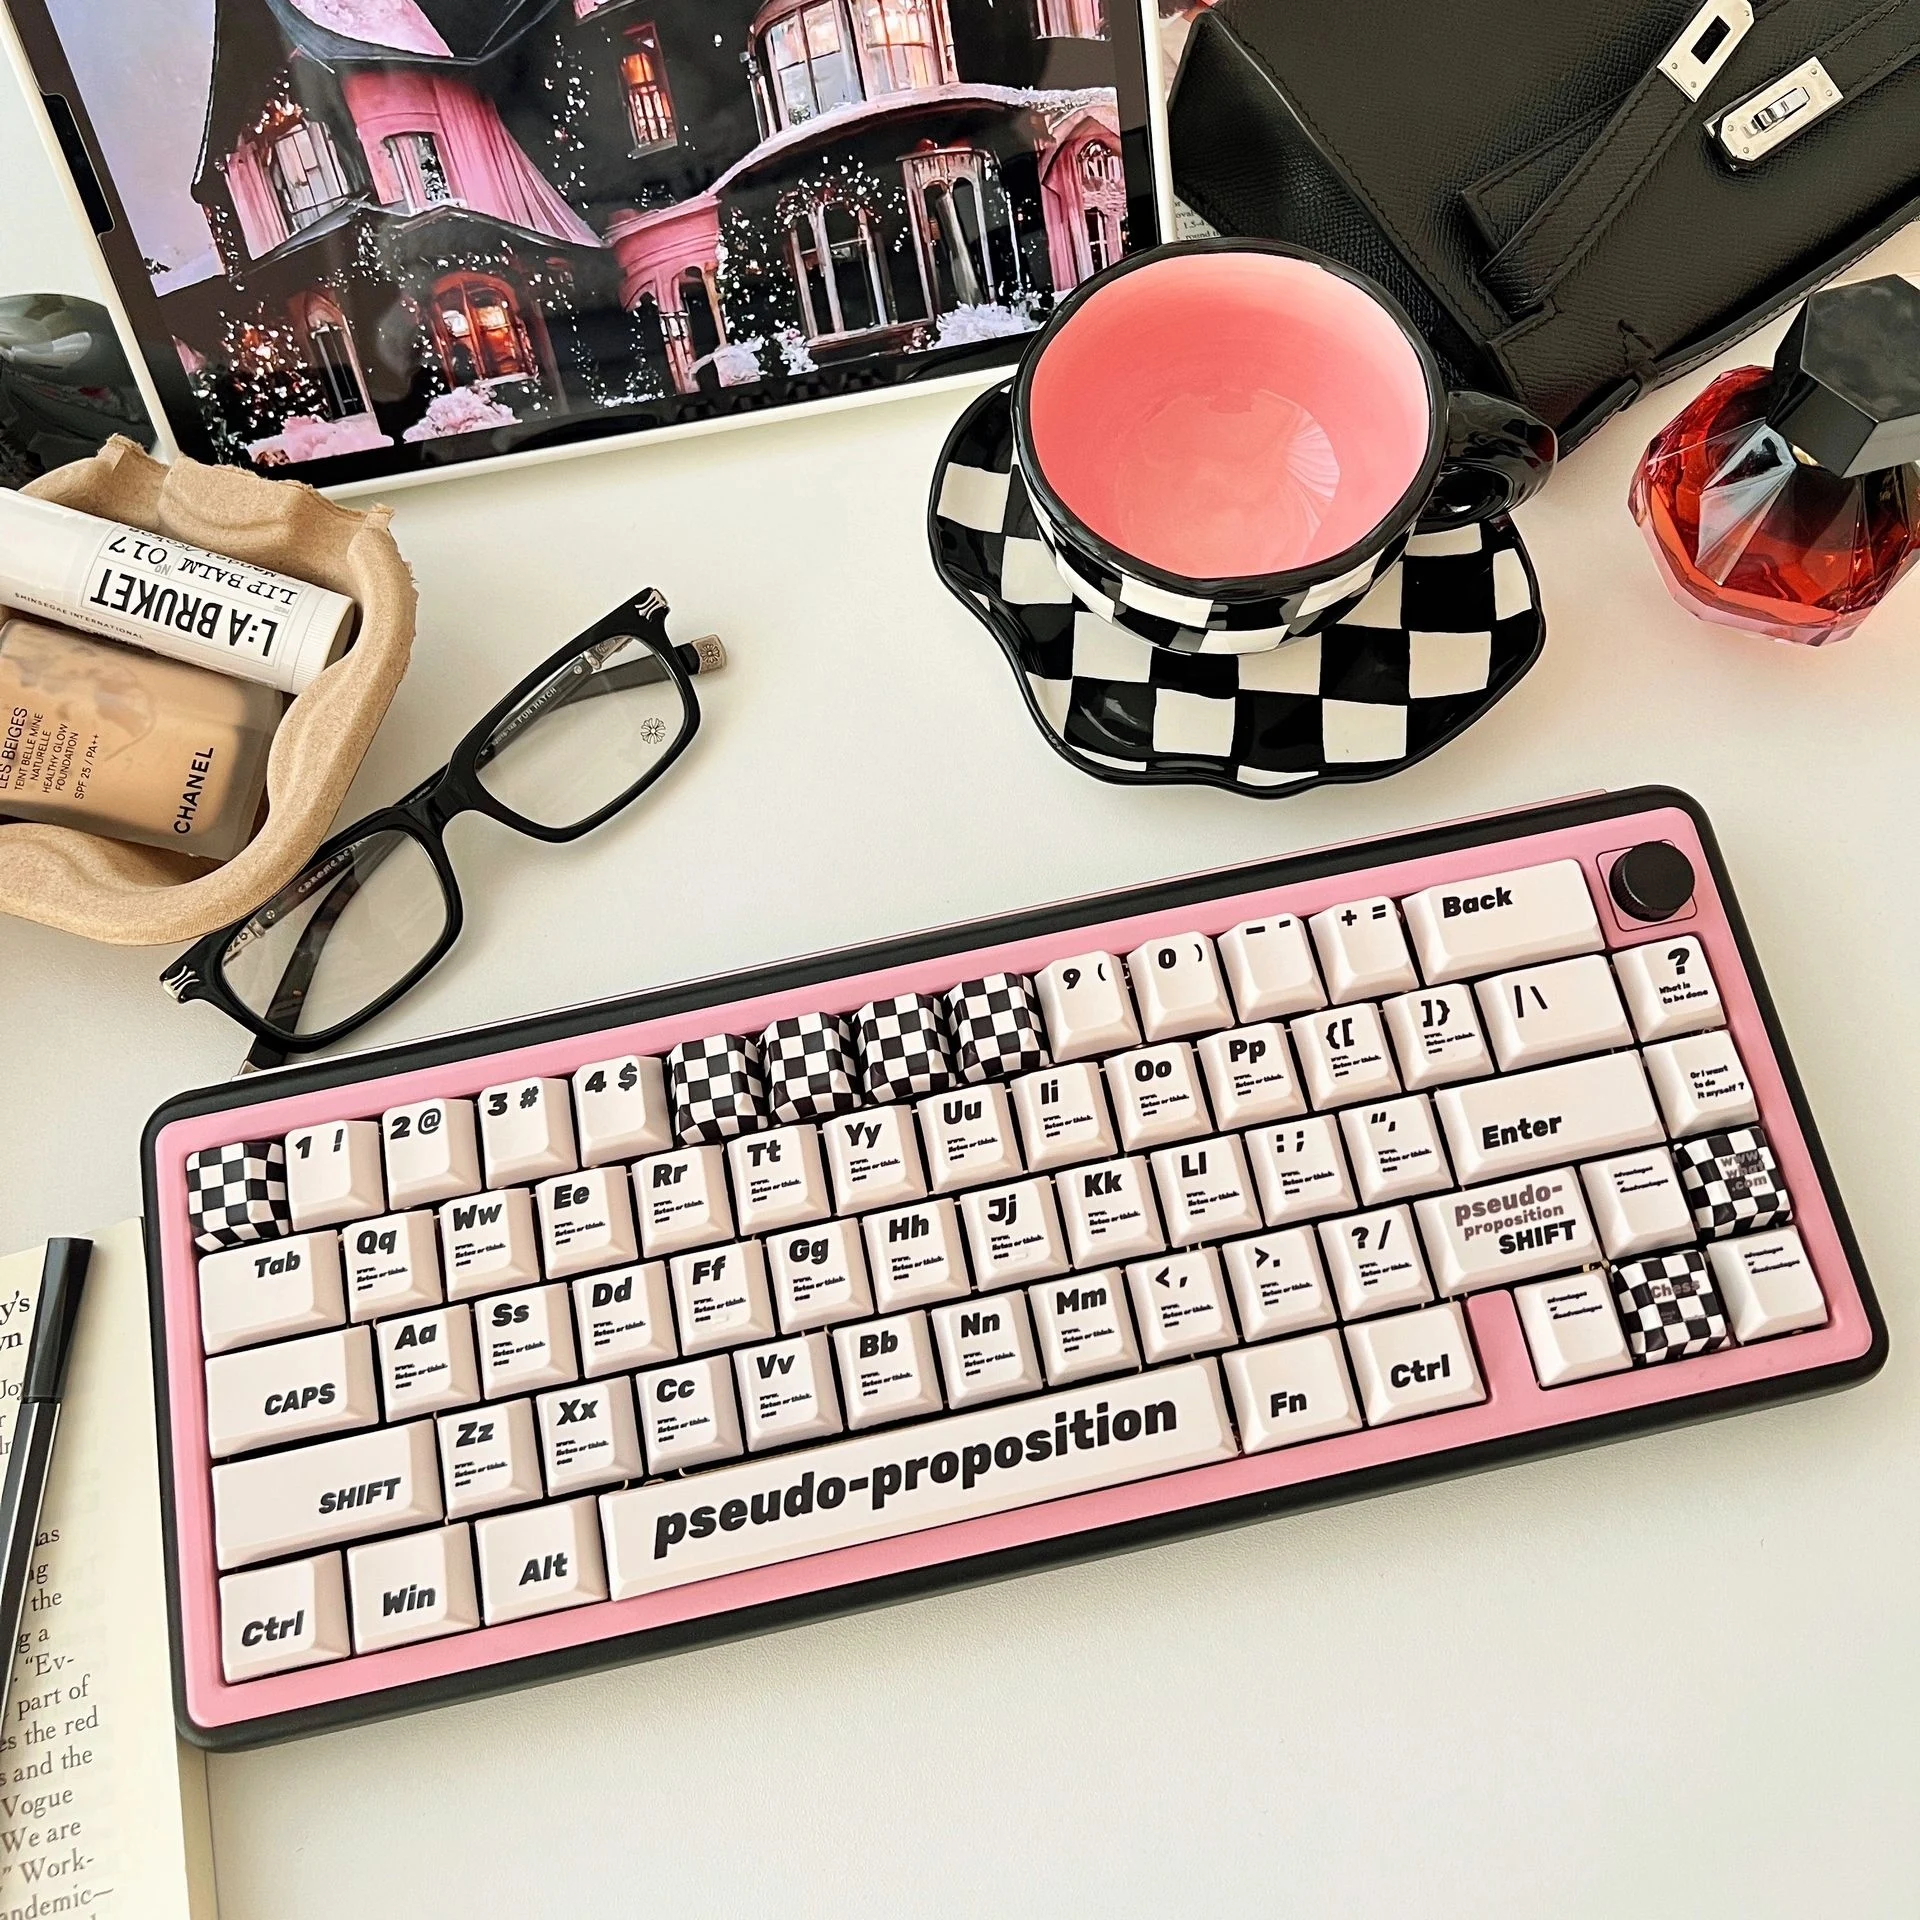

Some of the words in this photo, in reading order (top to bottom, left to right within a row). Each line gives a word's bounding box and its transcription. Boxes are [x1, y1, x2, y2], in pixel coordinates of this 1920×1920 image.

[178, 557, 244, 589] BALM
[90, 568, 223, 640] BRUKET
[246, 581, 298, 605] LIP
[15, 592, 67, 614] SHINSEGAE
[70, 611, 144, 639] INTERNATIONAL
[229, 608, 279, 657] L:A
[517, 709, 533, 726] FUN
[2, 707, 28, 761] BEIGES
[15, 768, 27, 790] TEINT
[21, 739, 36, 766] BELLE
[29, 713, 43, 737] MINE
[30, 730, 51, 780] NATURELLE
[42, 755, 58, 793] HEALTHY
[53, 723, 68, 753] GLOW
[56, 732, 78, 791] FOUNDATION
[74, 780, 87, 800] SPF
[81, 767, 91, 779] 25
[86, 735, 99, 758] PA++
[174, 747, 214, 834] CHANEL
[1342, 910, 1357, 926] +
[1372, 905, 1386, 919] =
[1443, 887, 1512, 918] Back
[1668, 948, 1689, 975] ?
[1063, 969, 1080, 989] 9
[1098, 964, 1106, 981] (
[1659, 983, 1681, 994] What
[1663, 996, 1672, 1004] to
[1674, 994, 1684, 1002] be
[1686, 989, 1709, 999] done
[1229, 1040, 1265, 1064] Pp
[585, 1071, 606, 1092] 4
[618, 1063, 637, 1091] $
[1706, 1065, 1728, 1076] want
[488, 1093, 507, 1116] 3
[520, 1086, 538, 1108] #
[1706, 1084, 1736, 1098] myself
[390, 1116, 410, 1140] 2
[418, 1108, 441, 1134] @
[944, 1100, 981, 1124] Uu
[296, 1136, 311, 1159] 1
[334, 1129, 343, 1152] !
[845, 1122, 882, 1148] Yy
[1483, 1116, 1561, 1149] Enter
[747, 1140, 781, 1167] Tt
[653, 1164, 687, 1188] Rr
[1085, 1171, 1122, 1197] Kk
[1731, 1175, 1768, 1192] .com
[554, 1184, 589, 1209] Ee
[988, 1194, 1016, 1225] Jj
[1454, 1182, 1564, 1227] pseudo-
[453, 1204, 502, 1231] Ww
[889, 1215, 929, 1242] Hh
[1464, 1204, 1565, 1241] proposition
[357, 1230, 396, 1254] Qq
[1499, 1219, 1576, 1254] SHIFT
[255, 1251, 300, 1278] Tab
[789, 1239, 828, 1264] Gg
[693, 1256, 726, 1285] Ff
[593, 1277, 632, 1307] Dd
[1057, 1288, 1106, 1314] Mm
[1650, 1280, 1701, 1299] Chess
[492, 1304, 529, 1327] Ss
[961, 1312, 999, 1338] Nn
[395, 1324, 436, 1350] Aa
[860, 1330, 897, 1358] Bb
[757, 1354, 794, 1379] Vv
[1391, 1354, 1450, 1388] Ctrl
[265, 1383, 335, 1415] CAPS
[657, 1379, 694, 1402] Cc
[1271, 1392, 1307, 1418] Fn
[557, 1399, 598, 1426] Xx
[456, 1422, 493, 1447] Zz
[654, 1399, 1176, 1559] pseudo-proposition
[319, 1478, 401, 1514] SHIFT
[519, 1553, 567, 1585] Alt
[32, 1588, 62, 1611] the
[384, 1585, 435, 1616] Win
[38, 1628, 50, 1642] a
[242, 1611, 304, 1646] Ctrl
[17, 1688, 62, 1721] part
[69, 1673, 91, 1700] of
[25, 1720, 56, 1746] the
[65, 1704, 100, 1736] red
[14, 1751, 53, 1783] and
[61, 1745, 93, 1770] the
[0, 1789, 73, 1819] Vogue
[0, 1826, 40, 1854] We
[47, 1821, 81, 1843] are
[19, 1847, 95, 1884] Work-
